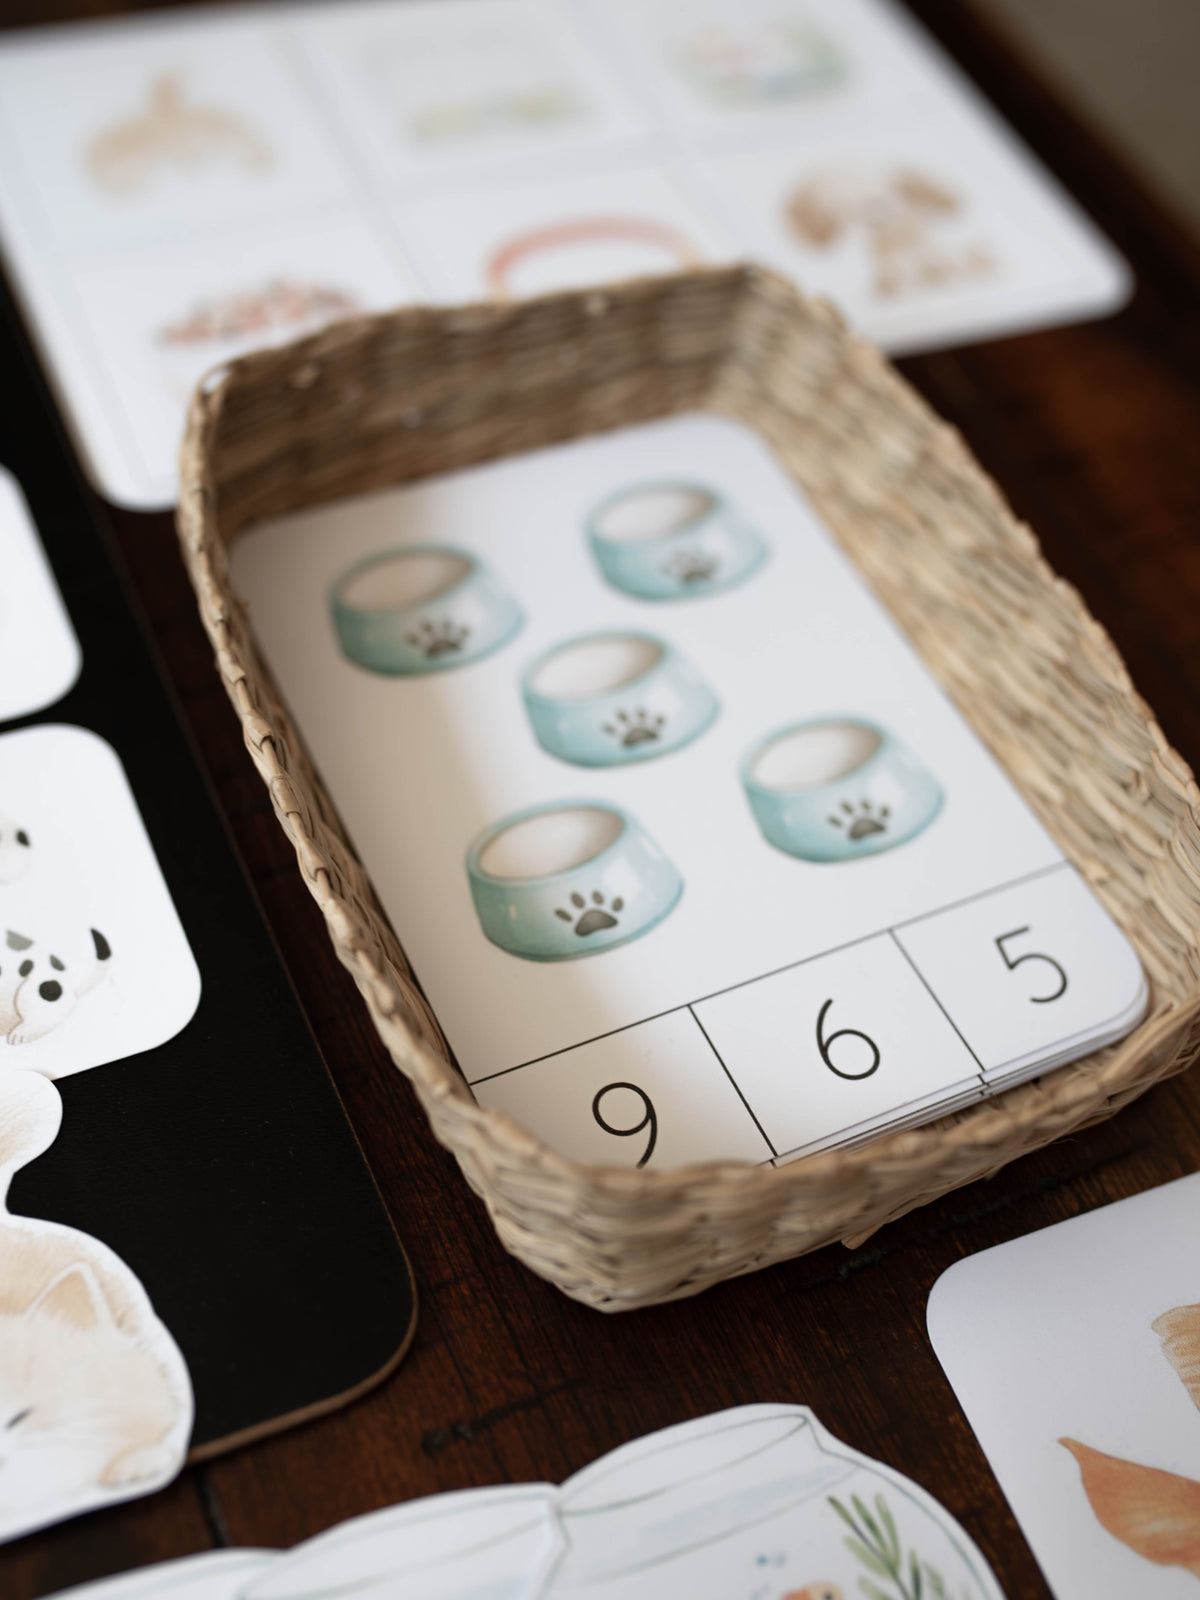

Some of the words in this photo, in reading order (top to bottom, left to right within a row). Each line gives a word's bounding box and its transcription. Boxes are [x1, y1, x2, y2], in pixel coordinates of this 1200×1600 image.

[592, 1082, 658, 1168] 9
[816, 998, 881, 1081] 6
[994, 926, 1068, 1004] 5
